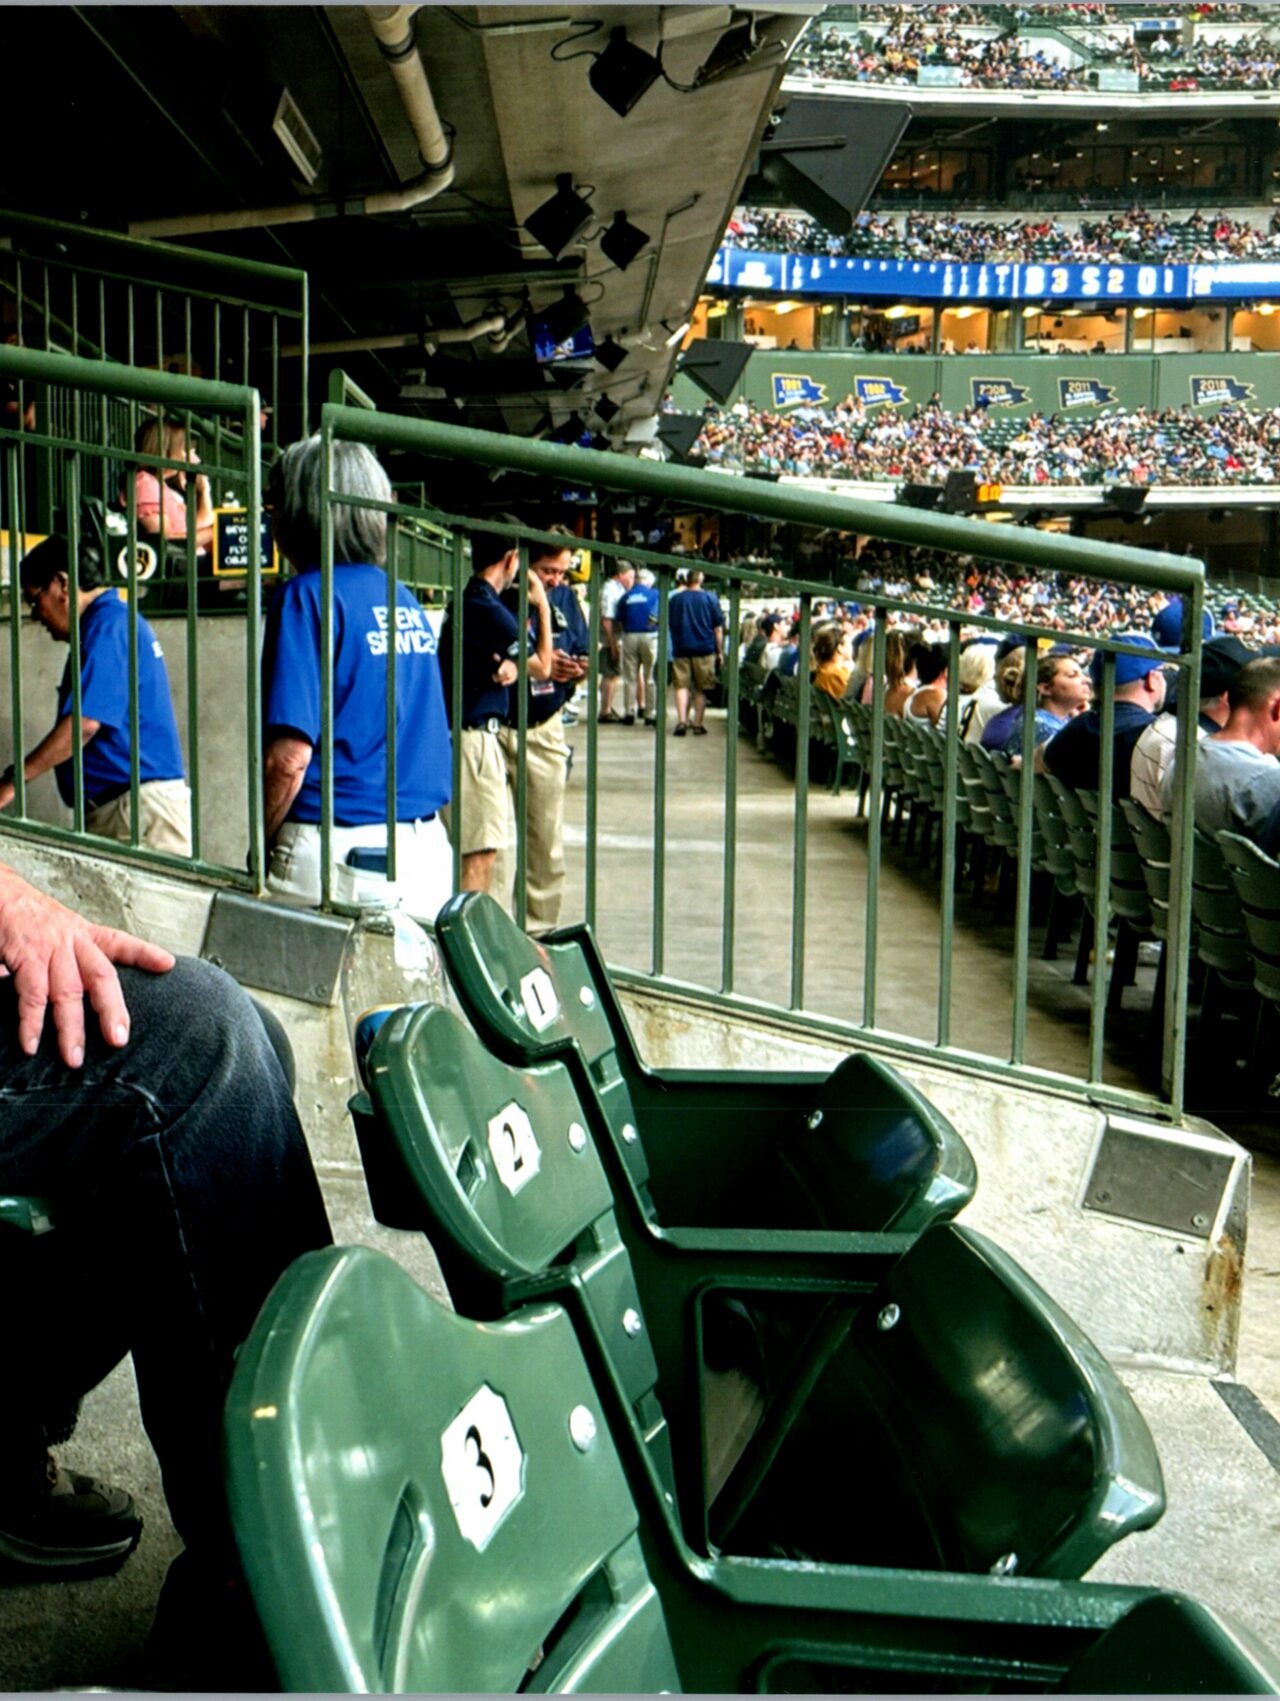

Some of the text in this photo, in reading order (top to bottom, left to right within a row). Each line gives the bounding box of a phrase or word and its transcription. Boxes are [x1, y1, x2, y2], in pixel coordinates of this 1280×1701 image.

[1050, 268, 1069, 294] 3
[1081, 266, 1101, 295] S
[1106, 268, 1124, 294] 2
[530, 982, 545, 1015] 1
[502, 1122, 524, 1173] 2
[464, 1424, 495, 1508] 3
